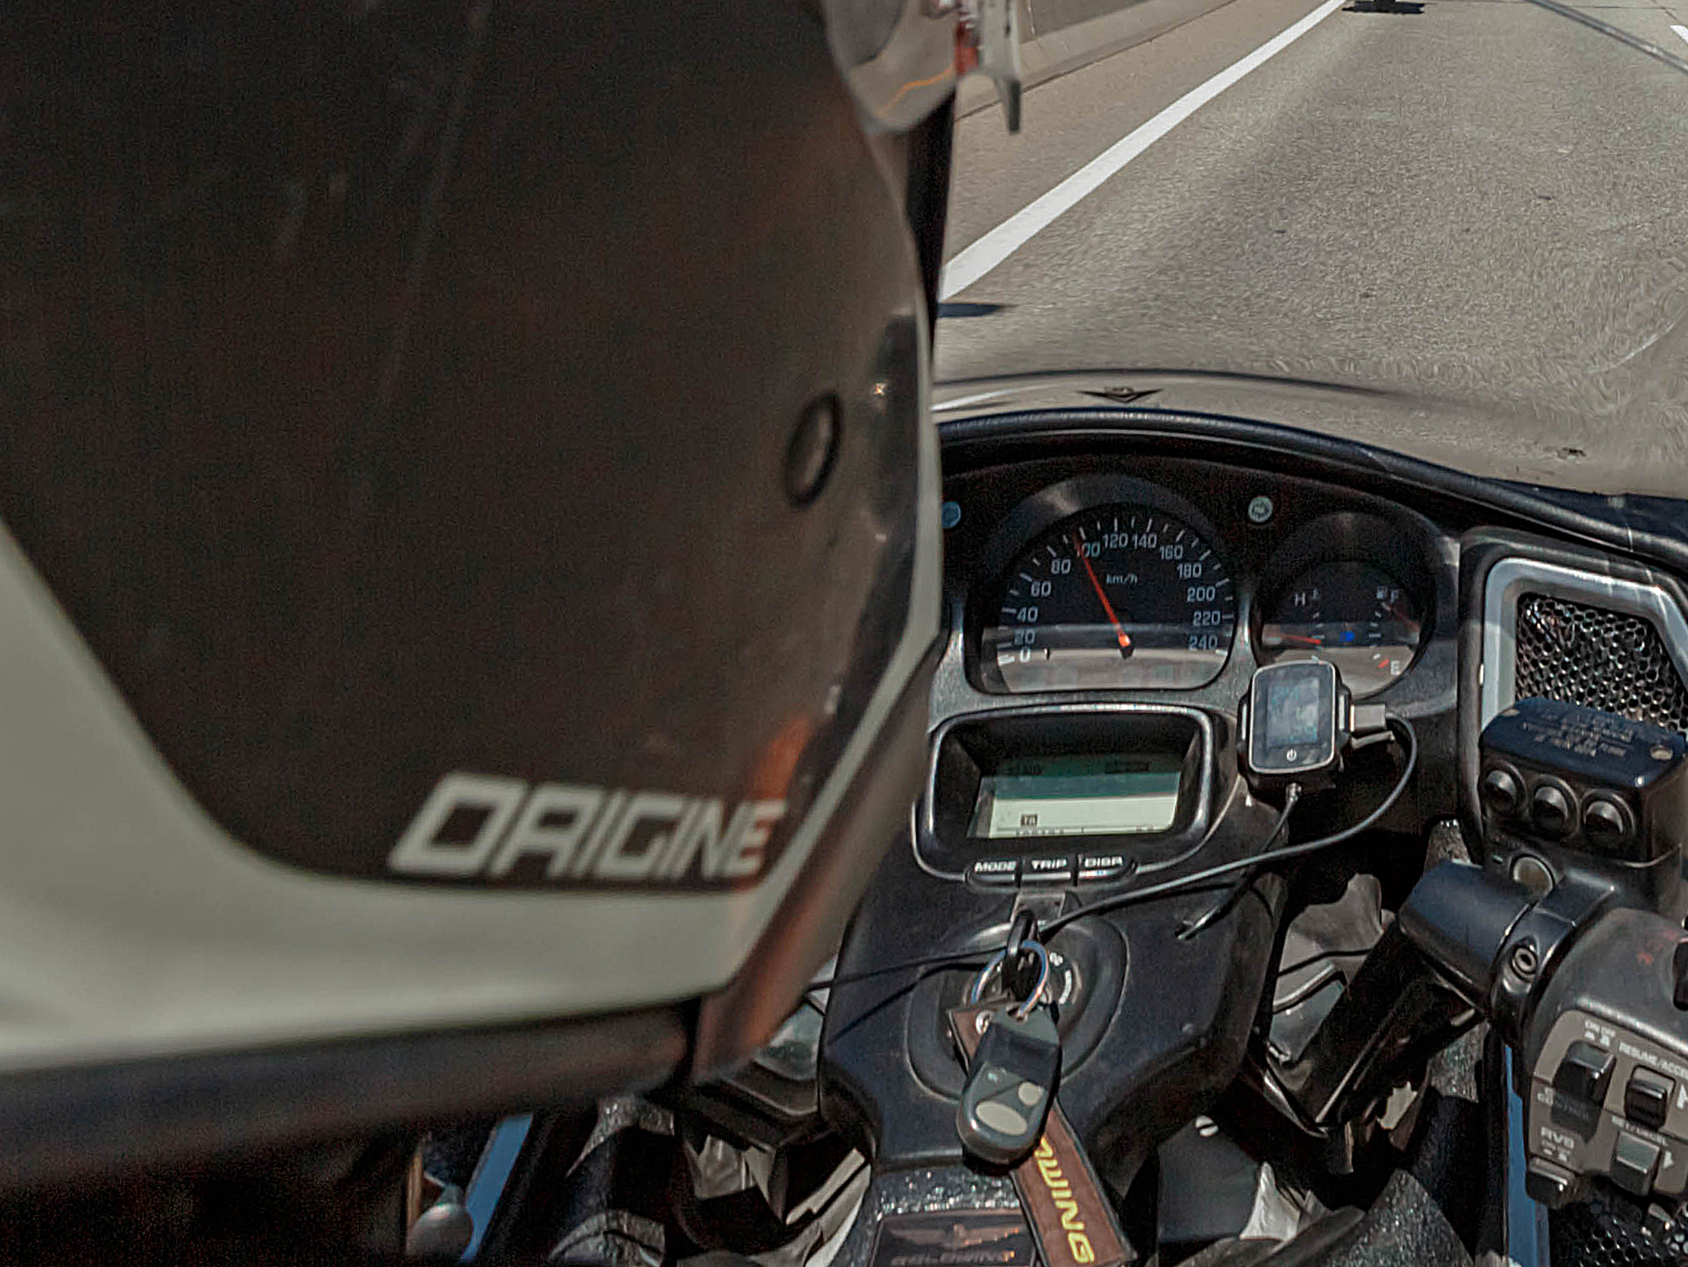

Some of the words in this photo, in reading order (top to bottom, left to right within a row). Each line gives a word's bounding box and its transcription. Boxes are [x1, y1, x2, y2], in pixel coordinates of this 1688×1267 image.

[1103, 533, 1128, 548] 120
[1131, 534, 1157, 549] 140
[1159, 545, 1183, 560] 160
[1051, 559, 1072, 574] 80
[1177, 563, 1202, 578] 180
[1106, 572, 1138, 584] km/h
[1030, 581, 1052, 597] 60
[1186, 586, 1216, 602] 200
[1017, 607, 1038, 623] 40
[1193, 610, 1221, 626] 220
[1014, 629, 1036, 645] 20
[1189, 635, 1218, 651] 240
[1019, 647, 1031, 663] 0
[388, 770, 789, 879] ORIGINE
[974, 860, 1018, 872] MODE
[1031, 858, 1068, 870] TRIP
